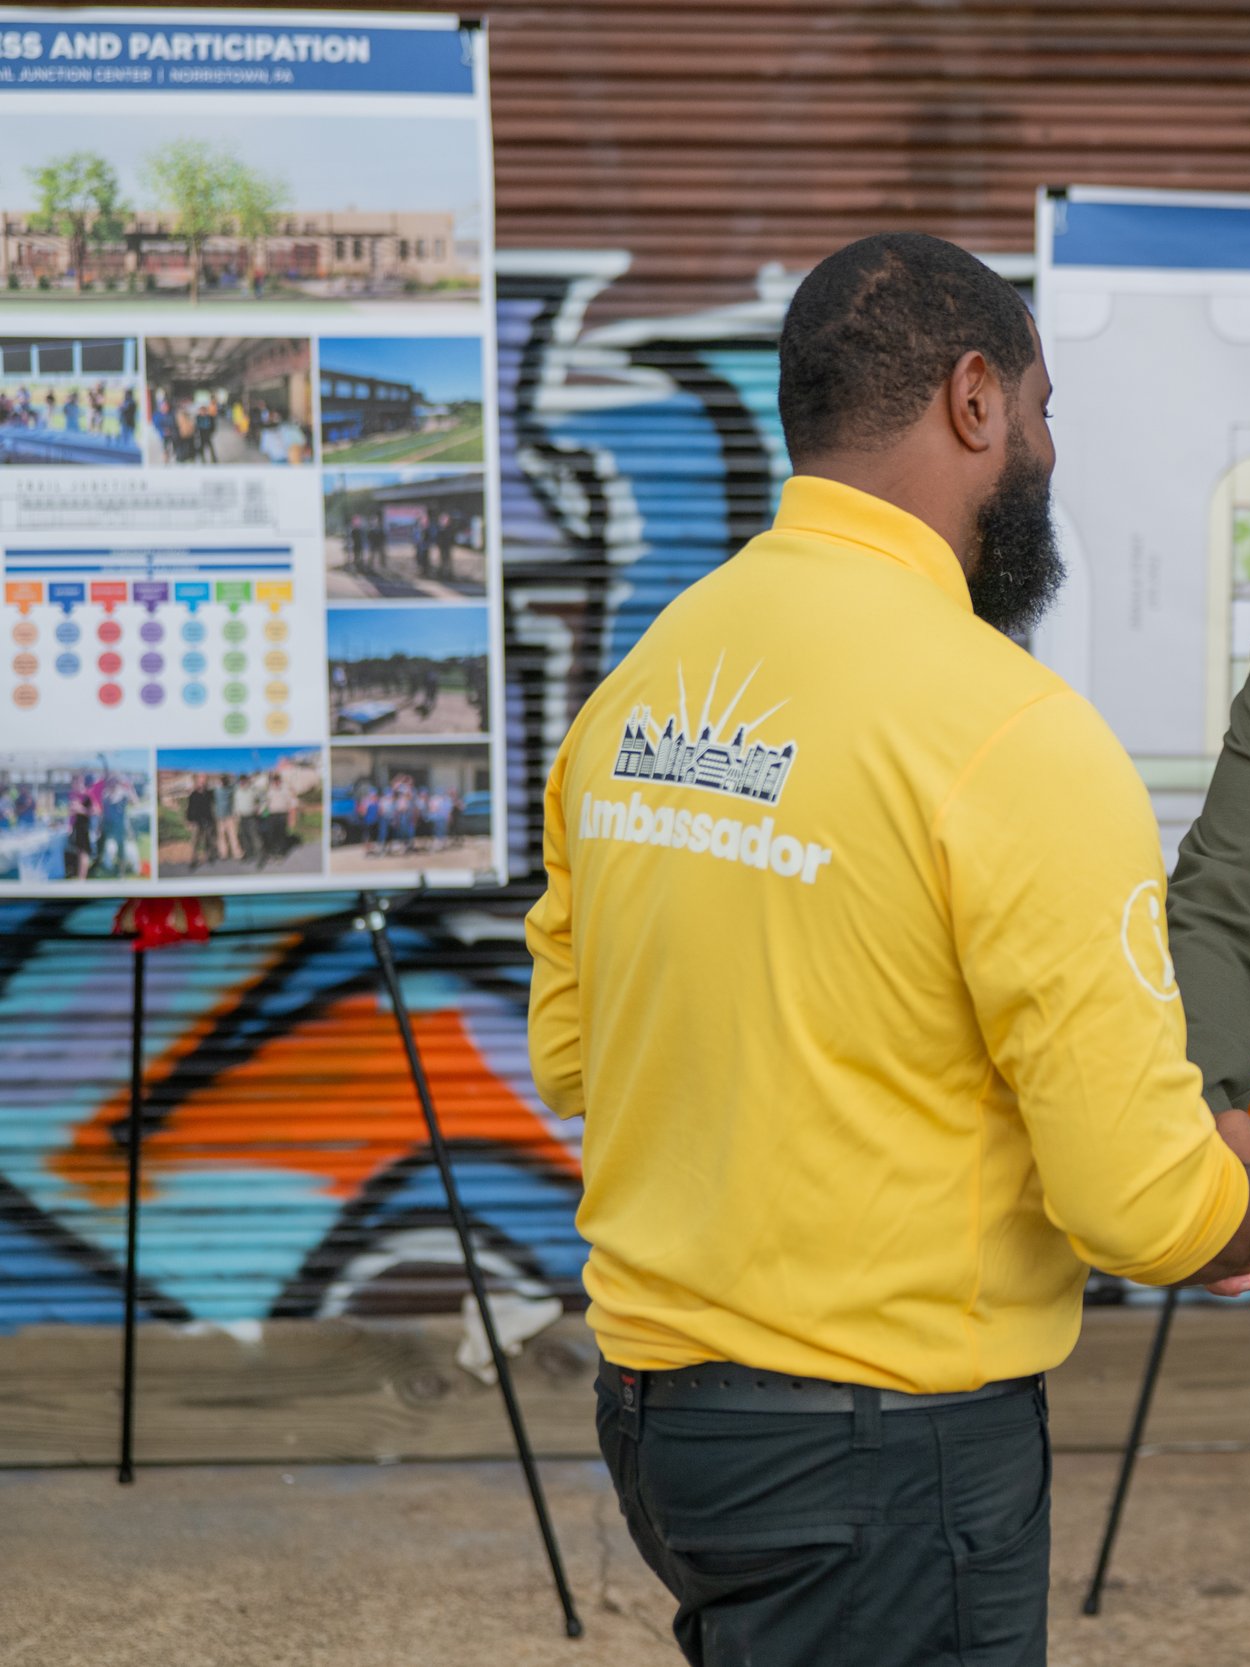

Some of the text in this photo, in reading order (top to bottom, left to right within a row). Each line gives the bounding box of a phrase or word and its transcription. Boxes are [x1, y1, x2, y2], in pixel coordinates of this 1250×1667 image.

[0, 31, 371, 63] SS AND PARTICIPATION
[18, 66, 92, 83] JUNCTION
[94, 66, 152, 83] CENTER
[169, 67, 271, 85] NORRISTOWN,
[273, 68, 295, 84] PA
